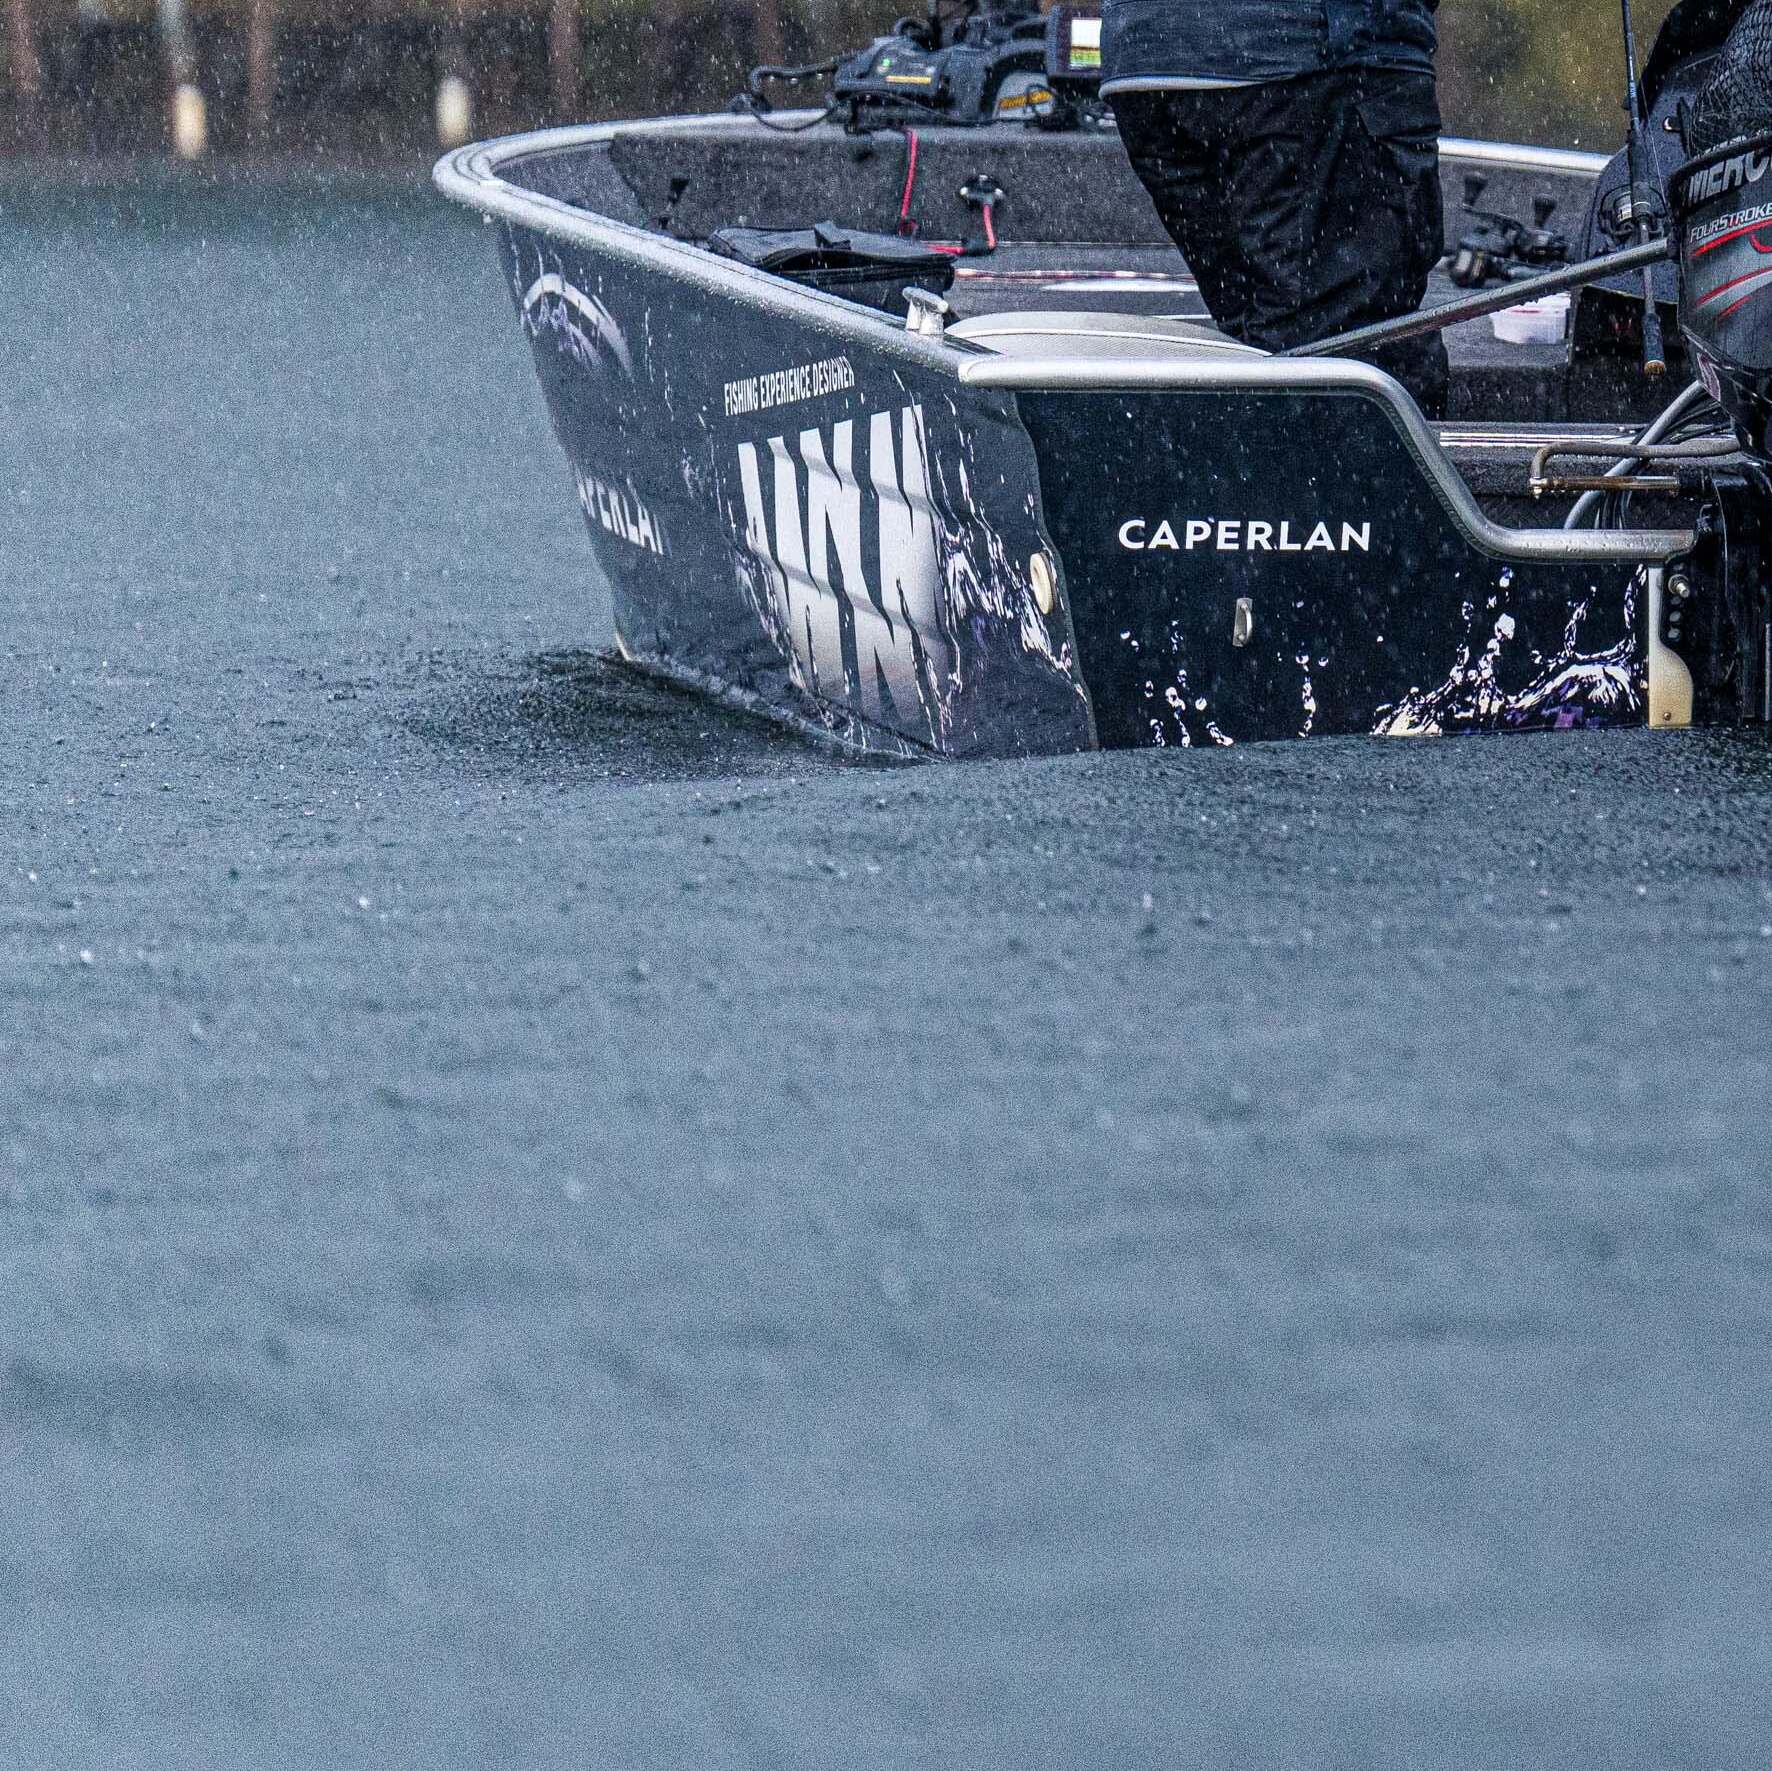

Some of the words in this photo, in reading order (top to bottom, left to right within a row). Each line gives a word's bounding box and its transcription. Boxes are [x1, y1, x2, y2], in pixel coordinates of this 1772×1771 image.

[724, 376, 758, 416] FISHING
[759, 364, 811, 408] EXPERIENCE
[812, 355, 855, 396] DESIGNER
[1118, 519, 1371, 551] CAPERLAN
